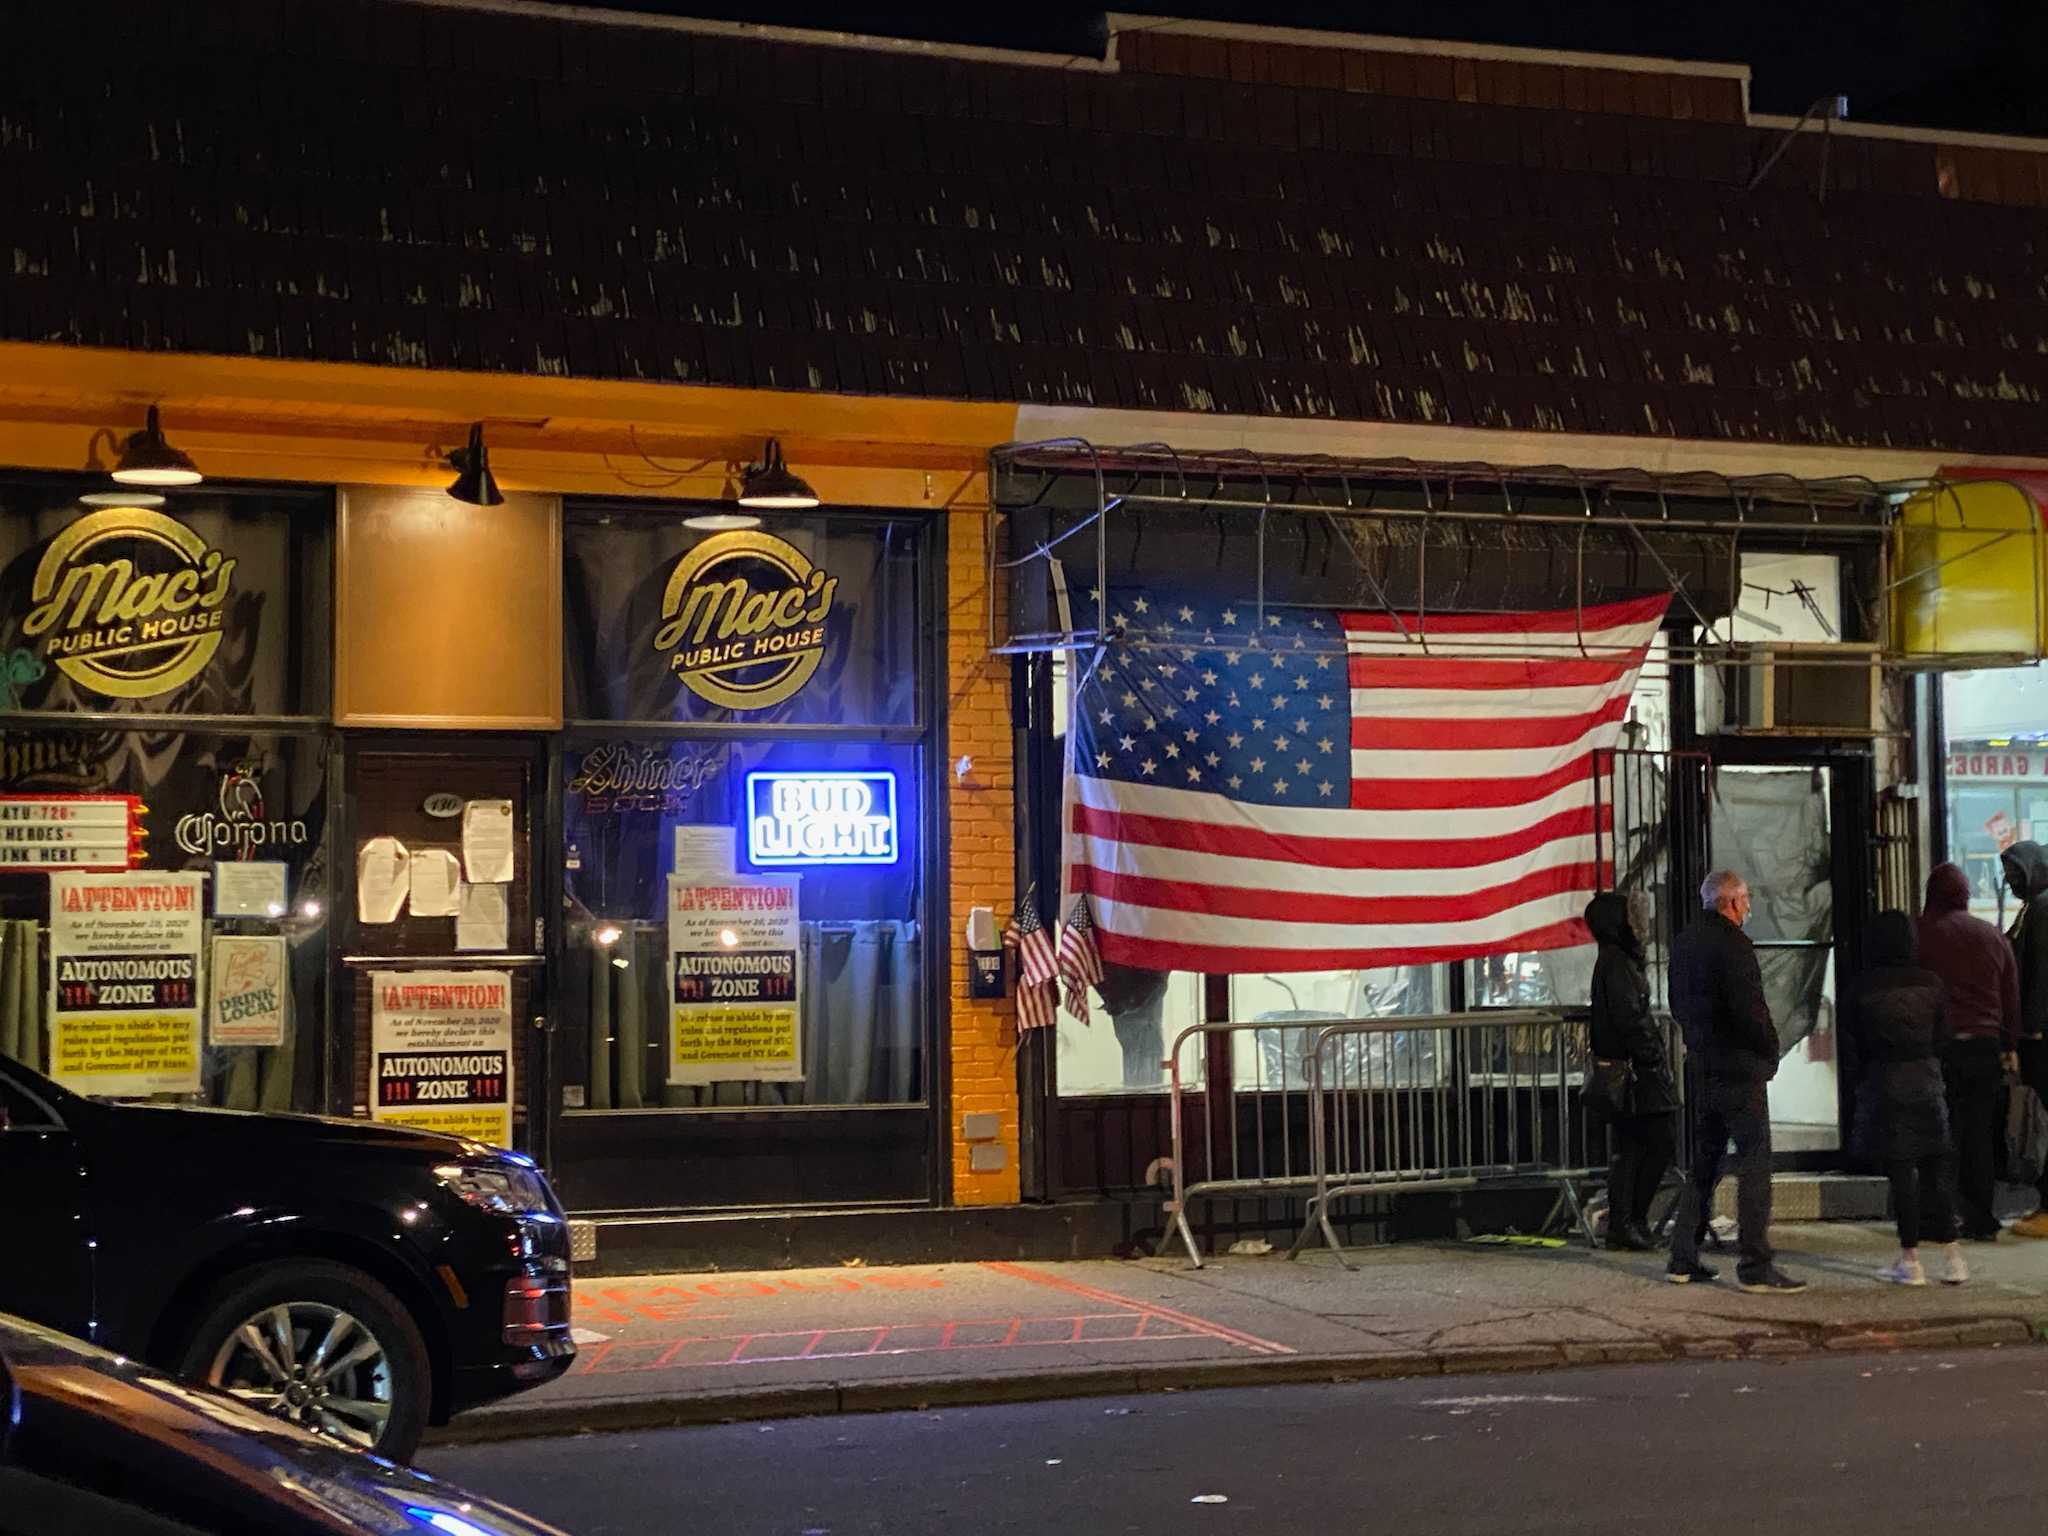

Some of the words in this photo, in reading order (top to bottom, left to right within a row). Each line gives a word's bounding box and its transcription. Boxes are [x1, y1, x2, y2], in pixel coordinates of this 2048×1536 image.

[22, 551, 236, 634] Mac's
[654, 570, 838, 650] Mac's
[47, 626, 132, 654] PUBLIC
[142, 610, 223, 640] HOUSE
[671, 642, 745, 669] PUBLIC
[753, 627, 825, 655] HOUSE
[568, 744, 719, 795] Shiner
[773, 780, 872, 815] BUD
[5, 827, 64, 841] HEROES
[175, 812, 308, 855] Corona
[755, 815, 891, 856] LIGHT
[40, 848, 78, 862] HERE
[60, 959, 192, 981] AUTONOMOUS
[678, 955, 792, 976] AUTONOMOUS
[98, 985, 155, 1004] ZONE
[711, 979, 760, 997] ZONE
[219, 988, 277, 1012] DRINK
[221, 1001, 279, 1024] LOCAL
[381, 1055, 503, 1077] AUTONOMOUS
[416, 1080, 469, 1100] ZONE
